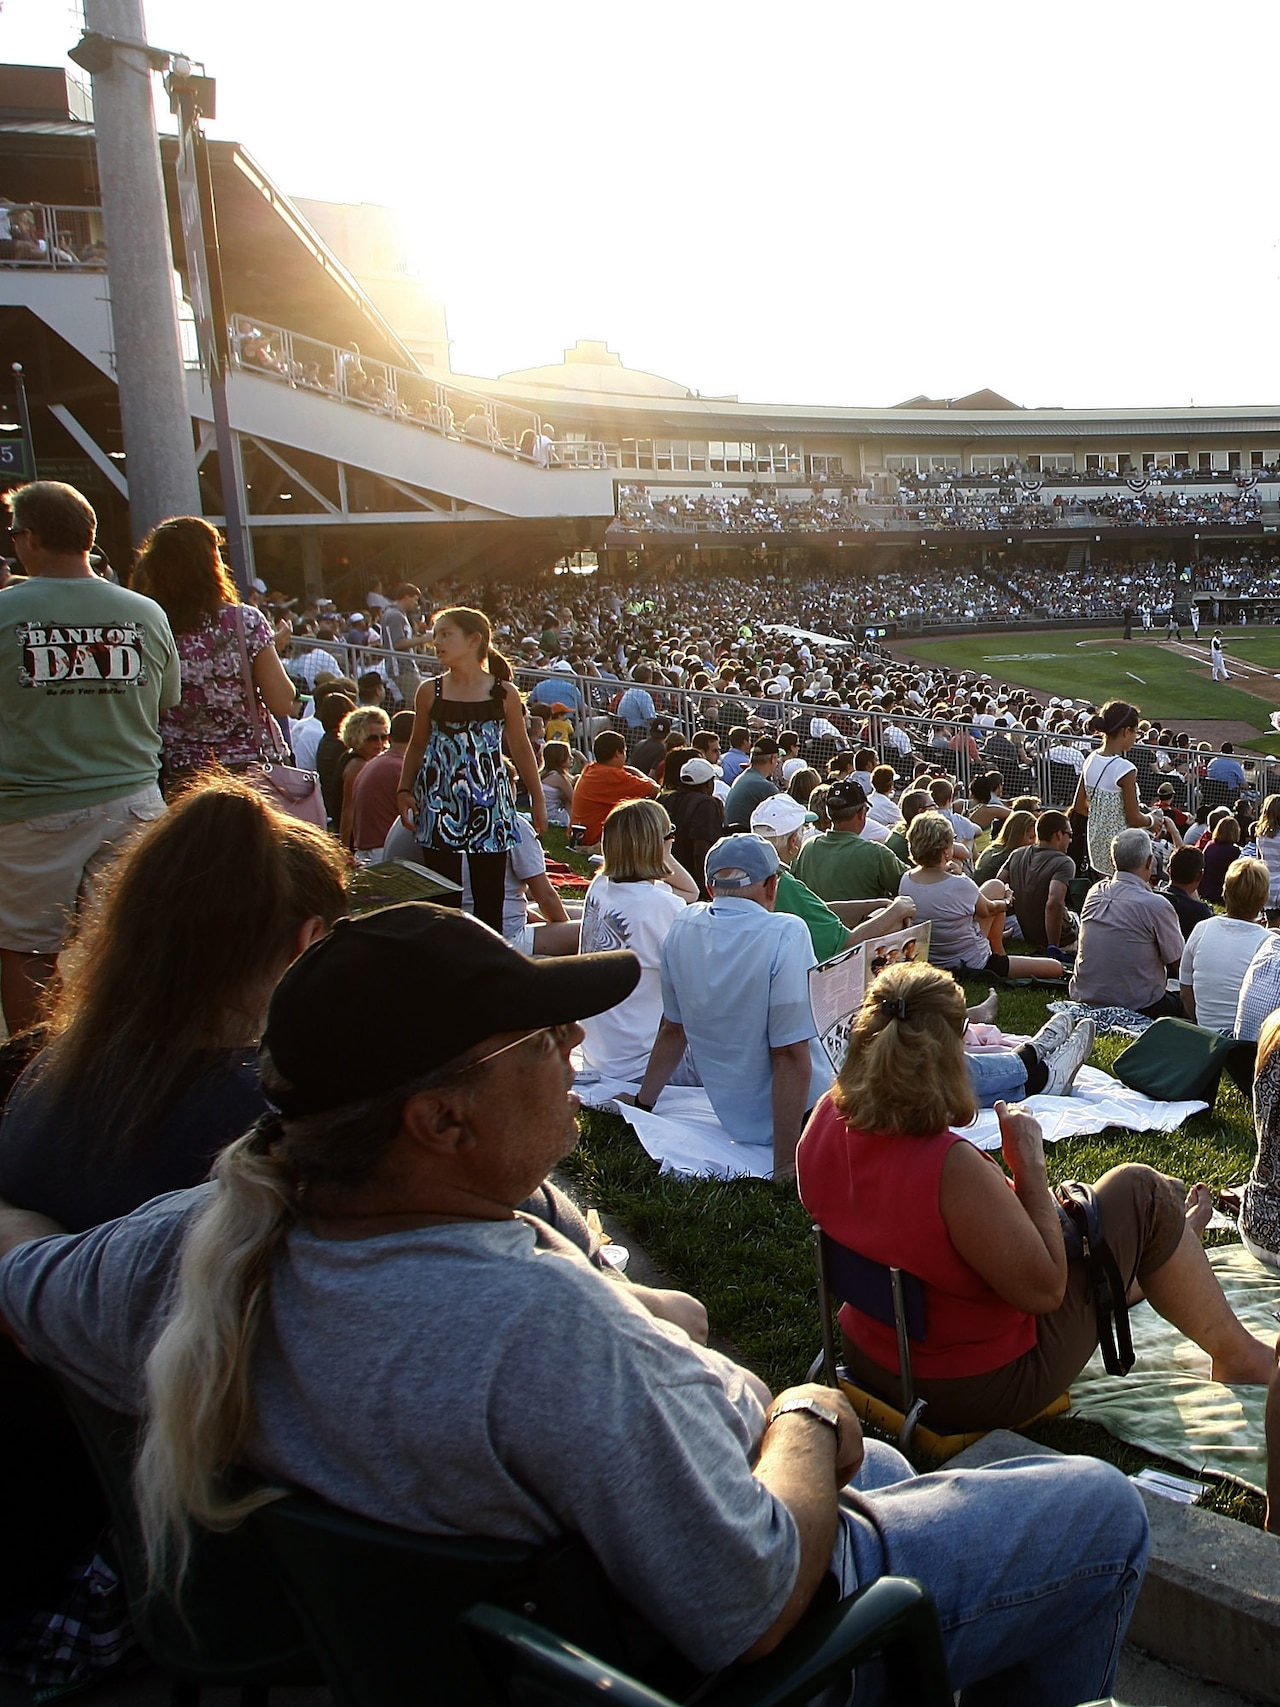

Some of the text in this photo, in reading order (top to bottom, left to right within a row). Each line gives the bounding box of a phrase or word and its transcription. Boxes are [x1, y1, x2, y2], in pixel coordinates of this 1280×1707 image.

[28, 628, 138, 646] BANK OF
[26, 645, 140, 680] DAD
